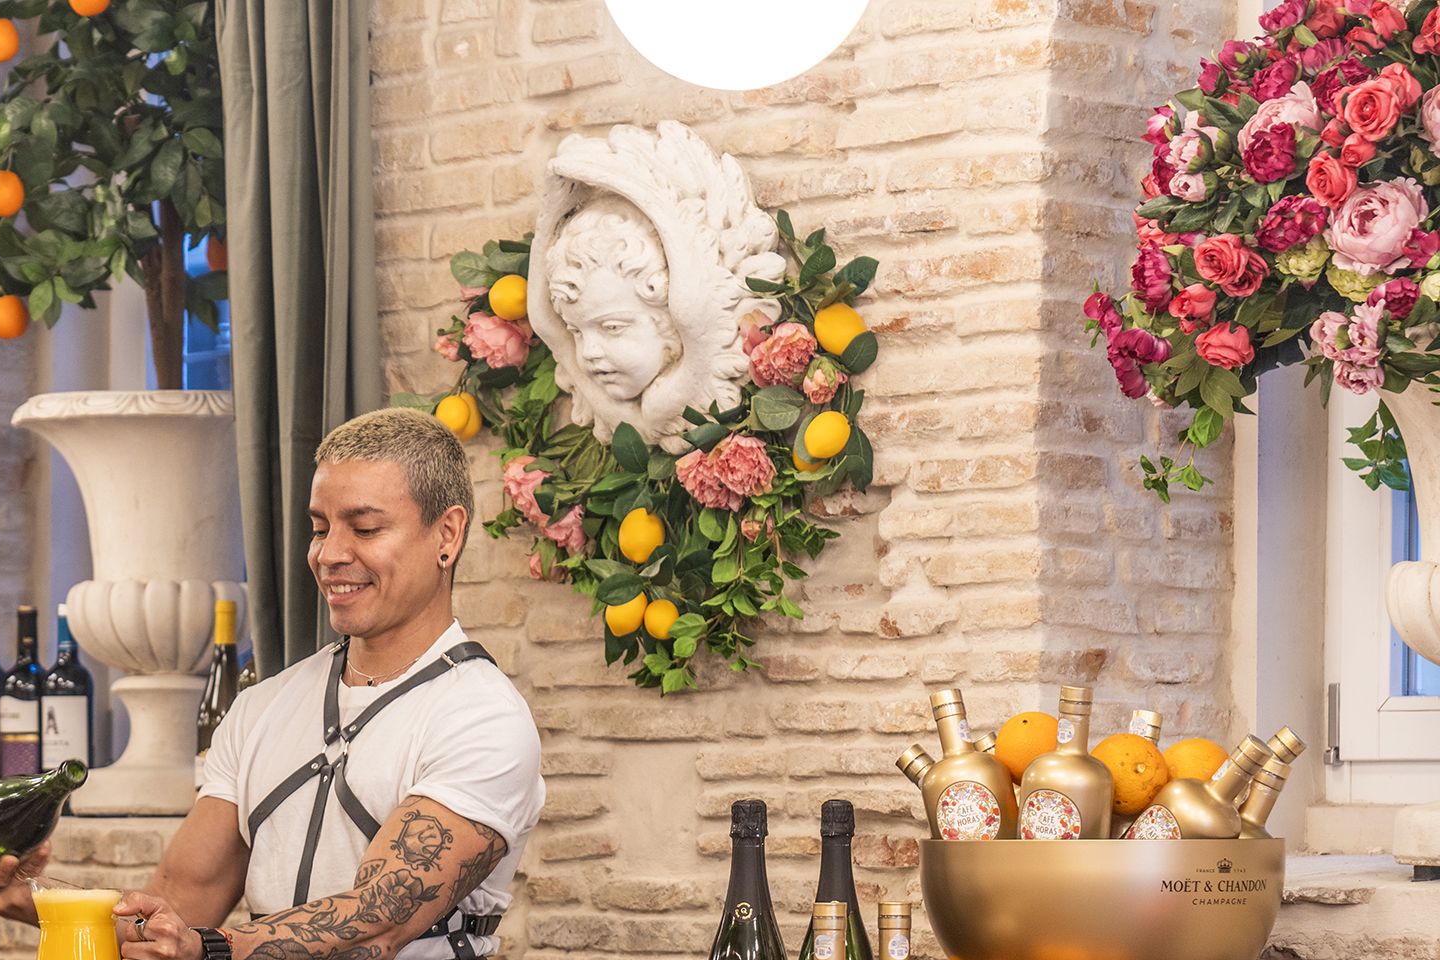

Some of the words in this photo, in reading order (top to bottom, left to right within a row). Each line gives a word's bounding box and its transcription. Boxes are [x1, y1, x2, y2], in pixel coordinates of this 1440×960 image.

[957, 815, 981, 827] HORAS
[1035, 825, 1058, 835] HORAS
[1160, 878, 1201, 892] MOËT
[1204, 880, 1213, 892] &
[1217, 879, 1267, 892] CHANDON
